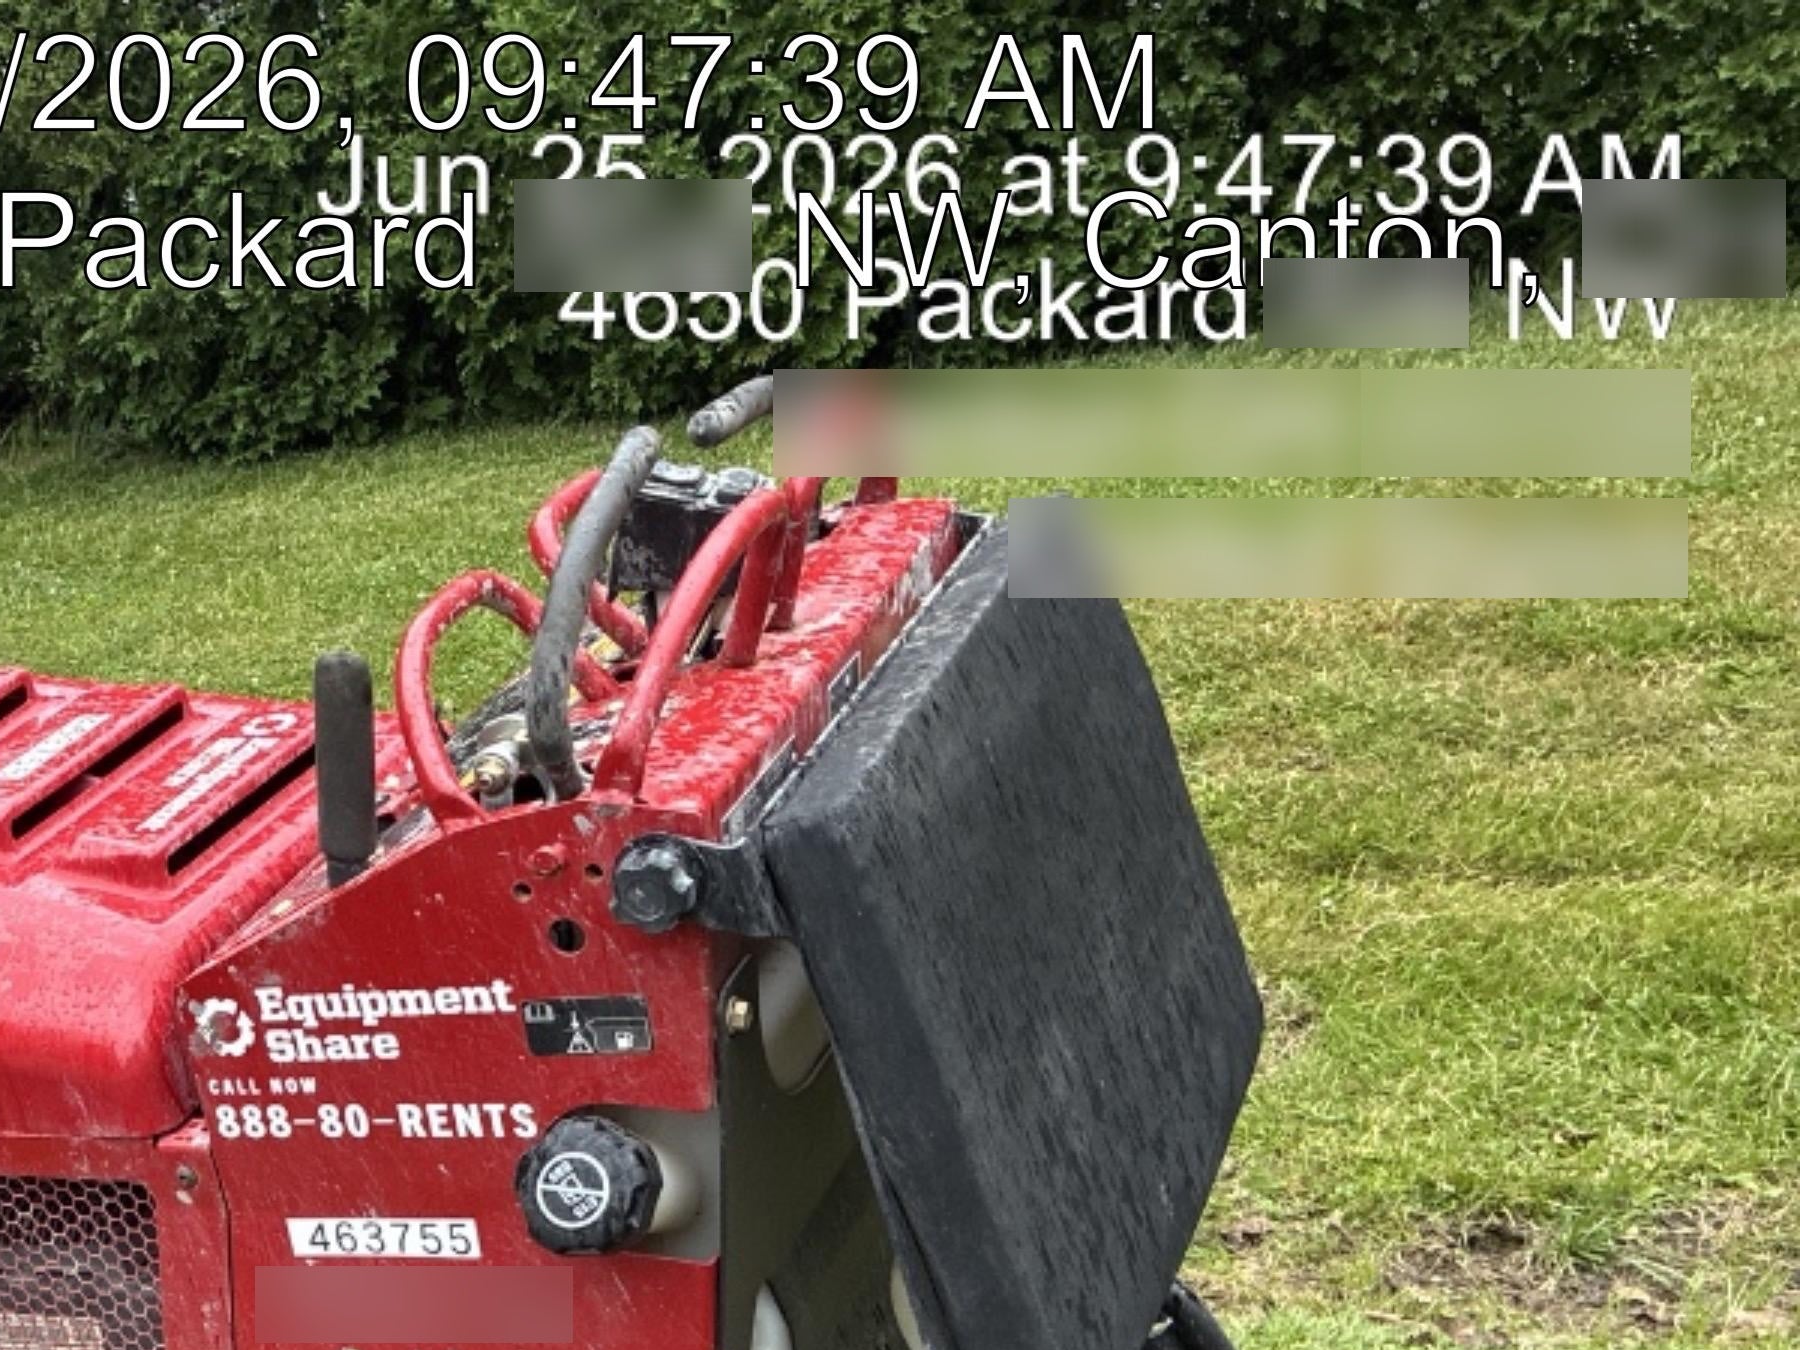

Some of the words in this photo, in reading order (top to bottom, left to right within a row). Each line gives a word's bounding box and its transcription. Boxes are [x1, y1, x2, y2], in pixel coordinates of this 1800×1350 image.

[254, 979, 517, 1027] Equipment
[265, 1028, 400, 1063] Share
[208, 1077, 262, 1096] CALL
[268, 1076, 317, 1095] NOW
[214, 1102, 539, 1139] 888-80-RENTS
[308, 1220, 473, 1256] 463755
